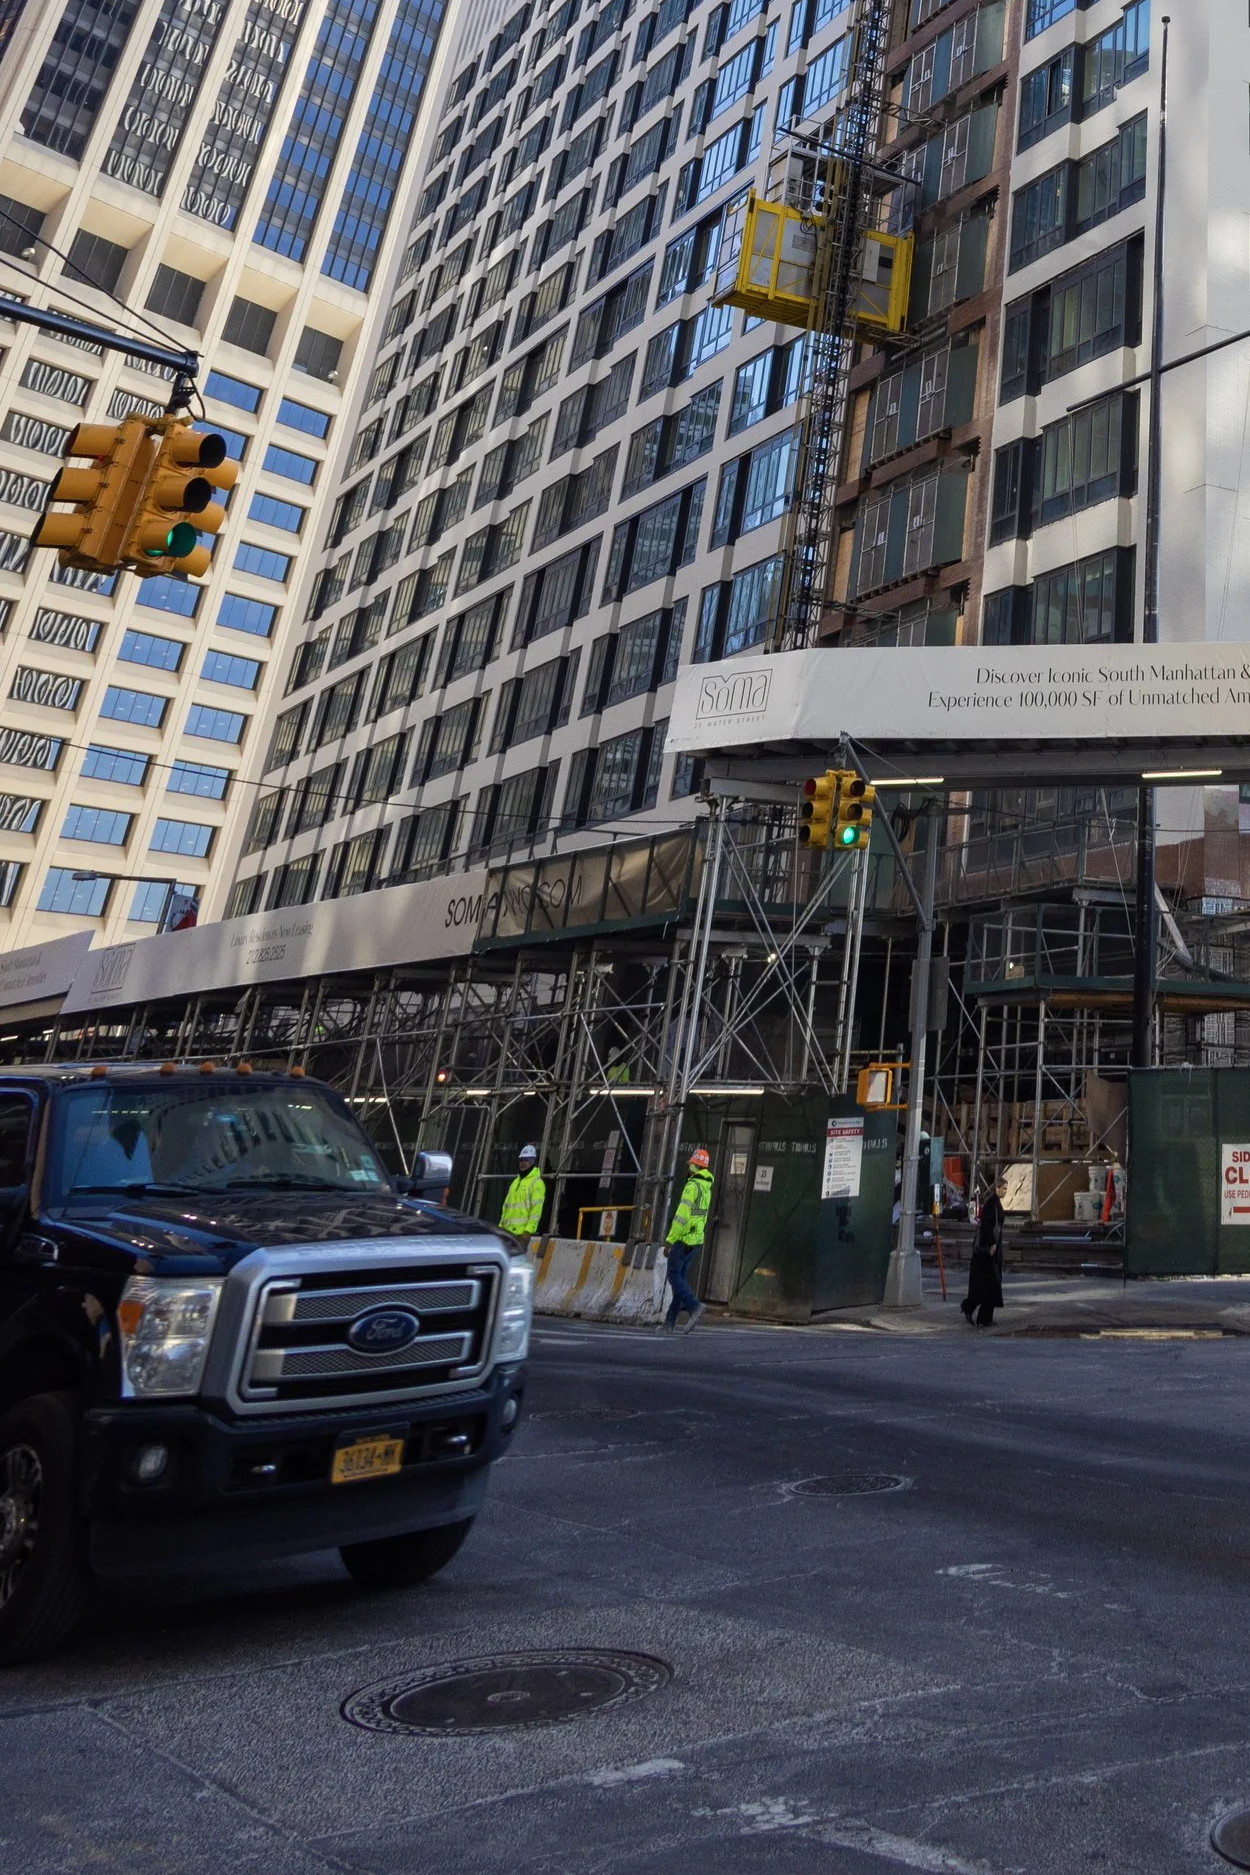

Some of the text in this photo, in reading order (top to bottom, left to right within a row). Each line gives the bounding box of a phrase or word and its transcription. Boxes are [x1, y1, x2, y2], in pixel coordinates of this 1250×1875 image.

[976, 667, 1044, 684] Discover
[1048, 667, 1094, 683] Iconic
[1098, 664, 1145, 683] South
[1150, 663, 1236, 681] Manhattan
[928, 691, 1013, 712] Experience
[1019, 690, 1078, 710] 100,000
[1081, 690, 1104, 707] SF
[1108, 688, 1124, 706] of
[1129, 687, 1220, 706] Unmatched
[736, 715, 766, 724] STREET
[1224, 1189, 1236, 1199] USE
[365, 1318, 407, 1341] Ford
